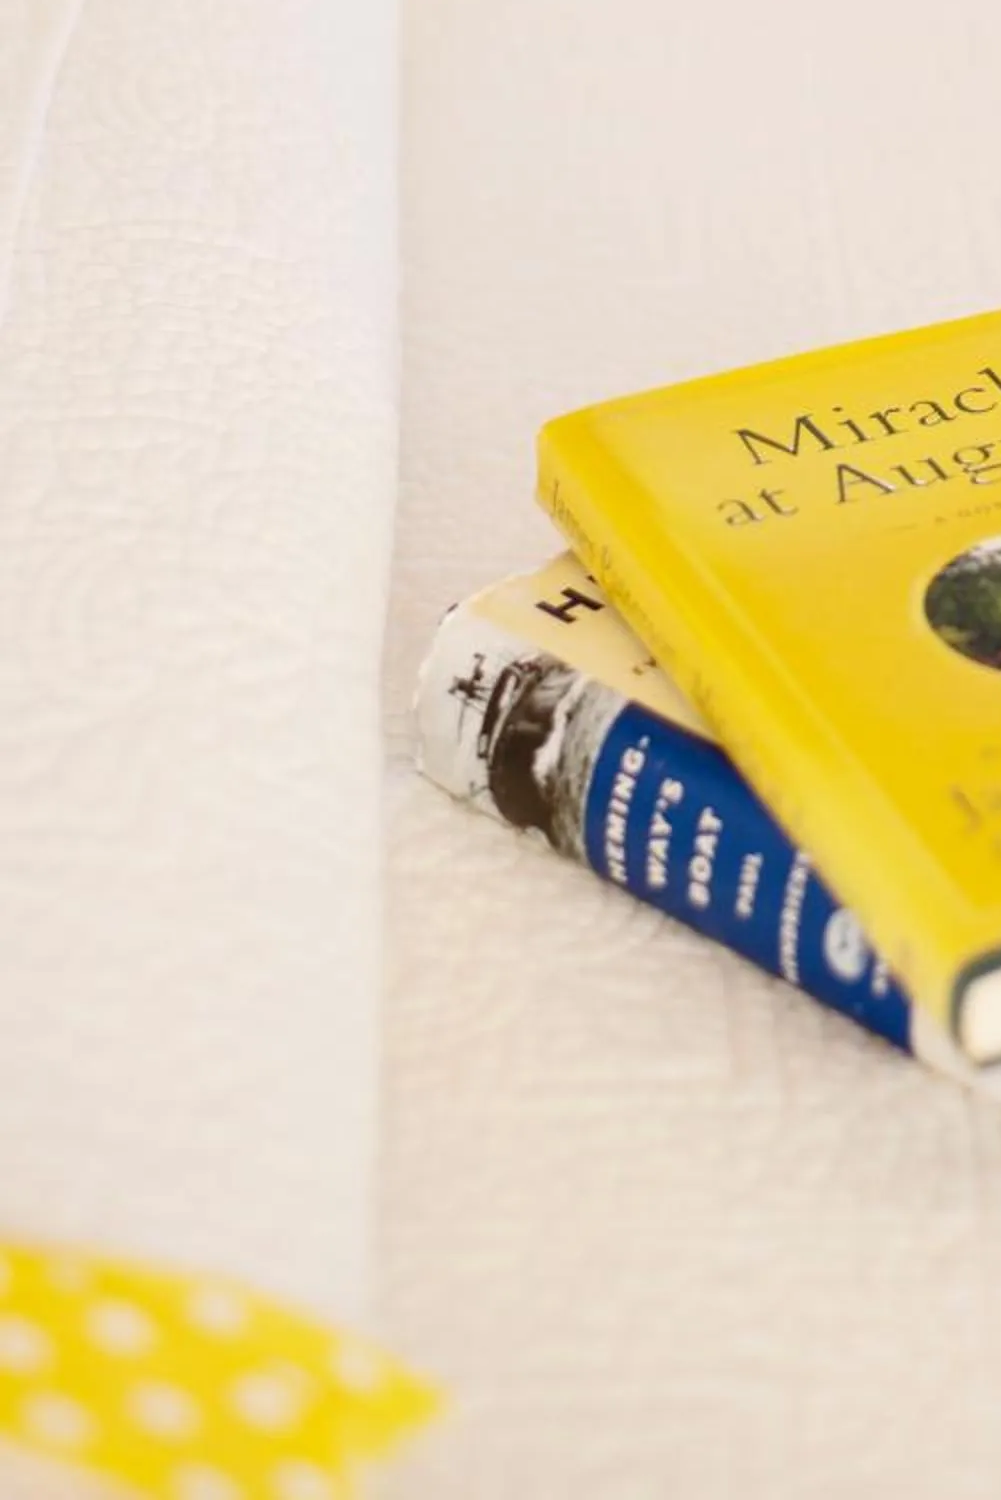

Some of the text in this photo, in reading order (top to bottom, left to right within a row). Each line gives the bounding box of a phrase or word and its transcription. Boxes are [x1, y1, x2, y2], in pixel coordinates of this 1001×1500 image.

[717, 486, 799, 527] at
[605, 735, 650, 884] HEMING-
[647, 777, 684, 888] WAY'S
[688, 806, 724, 910] BOAT
